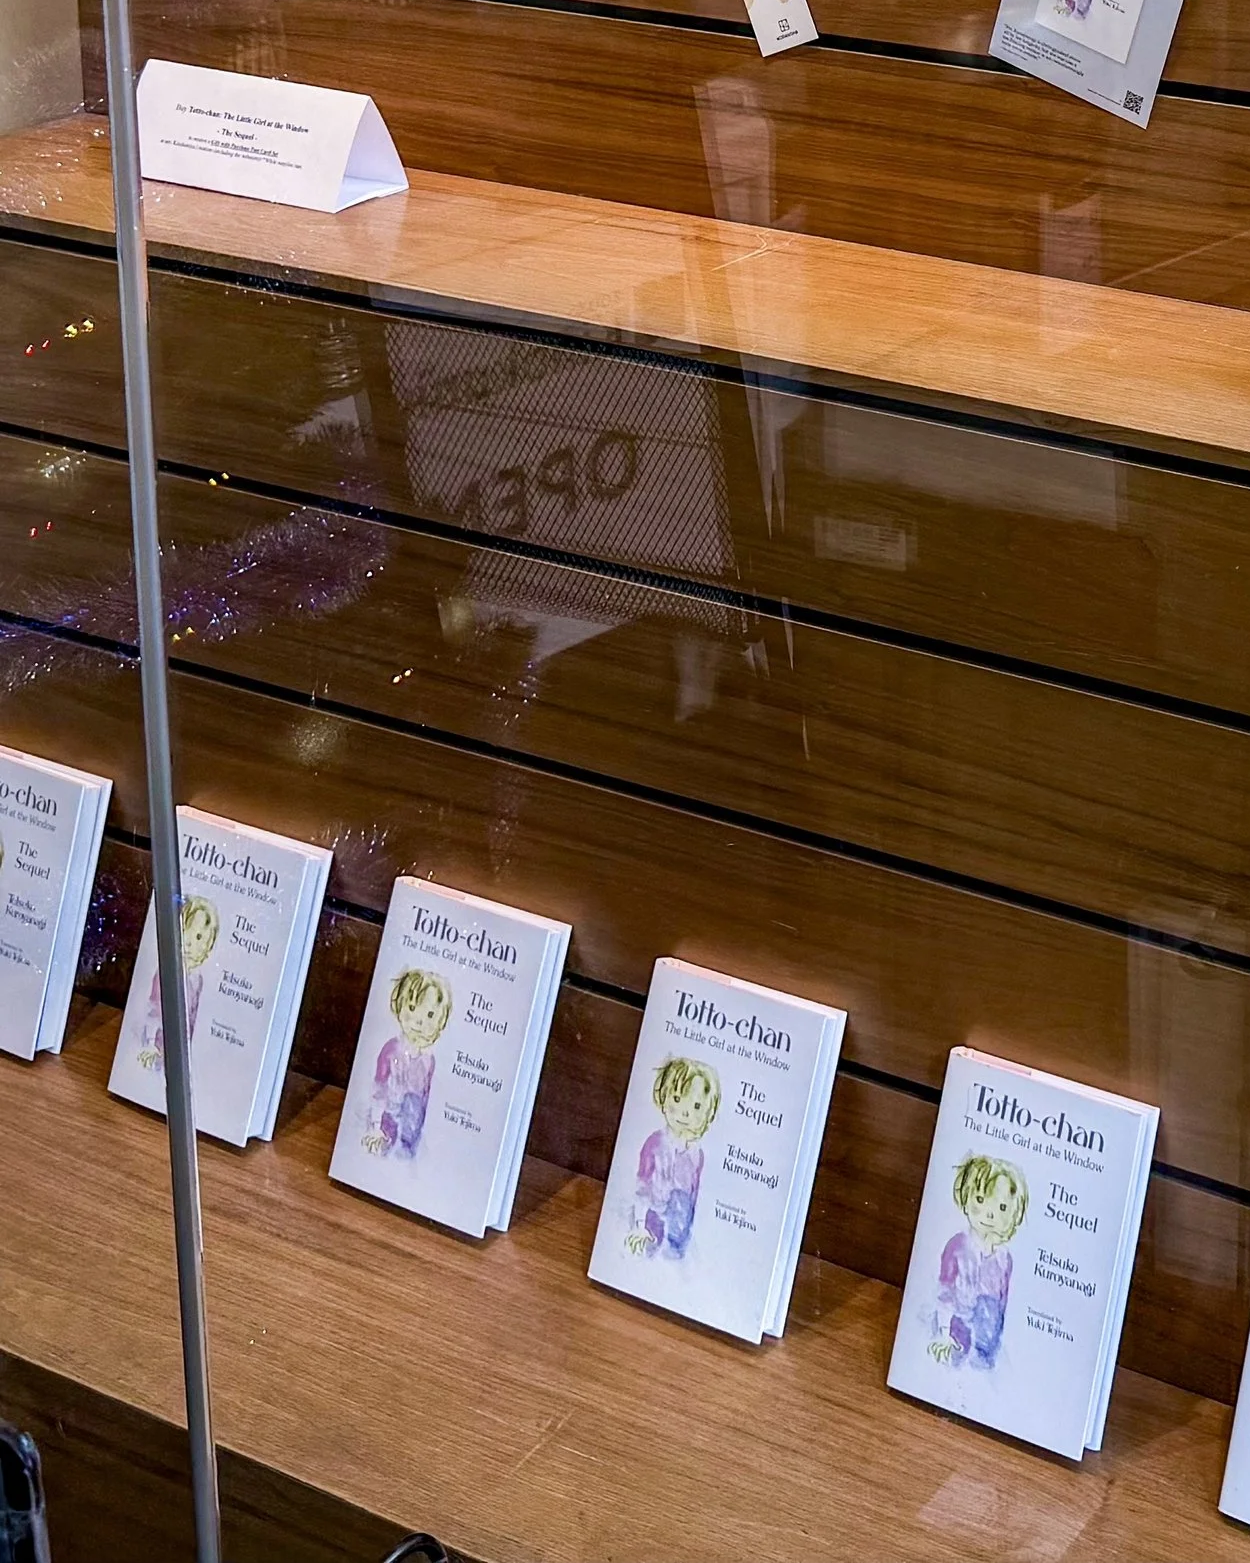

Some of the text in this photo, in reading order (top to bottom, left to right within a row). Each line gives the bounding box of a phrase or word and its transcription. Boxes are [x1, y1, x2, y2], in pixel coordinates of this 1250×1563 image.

[18, 840, 38, 859] The
[183, 833, 278, 888] Totto-chan
[14, 856, 51, 880] Sequel
[235, 914, 257, 934] The
[412, 905, 517, 965] Totto-chan
[230, 933, 270, 956] Sequel
[470, 991, 494, 1012] The
[464, 1010, 508, 1036] Sequel
[675, 989, 792, 1053] Totto-chan
[740, 1080, 766, 1103] The
[734, 1101, 783, 1128] Sequel
[973, 1082, 1105, 1153] Totto-chan
[1049, 1181, 1078, 1207] The
[1044, 1203, 1099, 1234] Sequel
